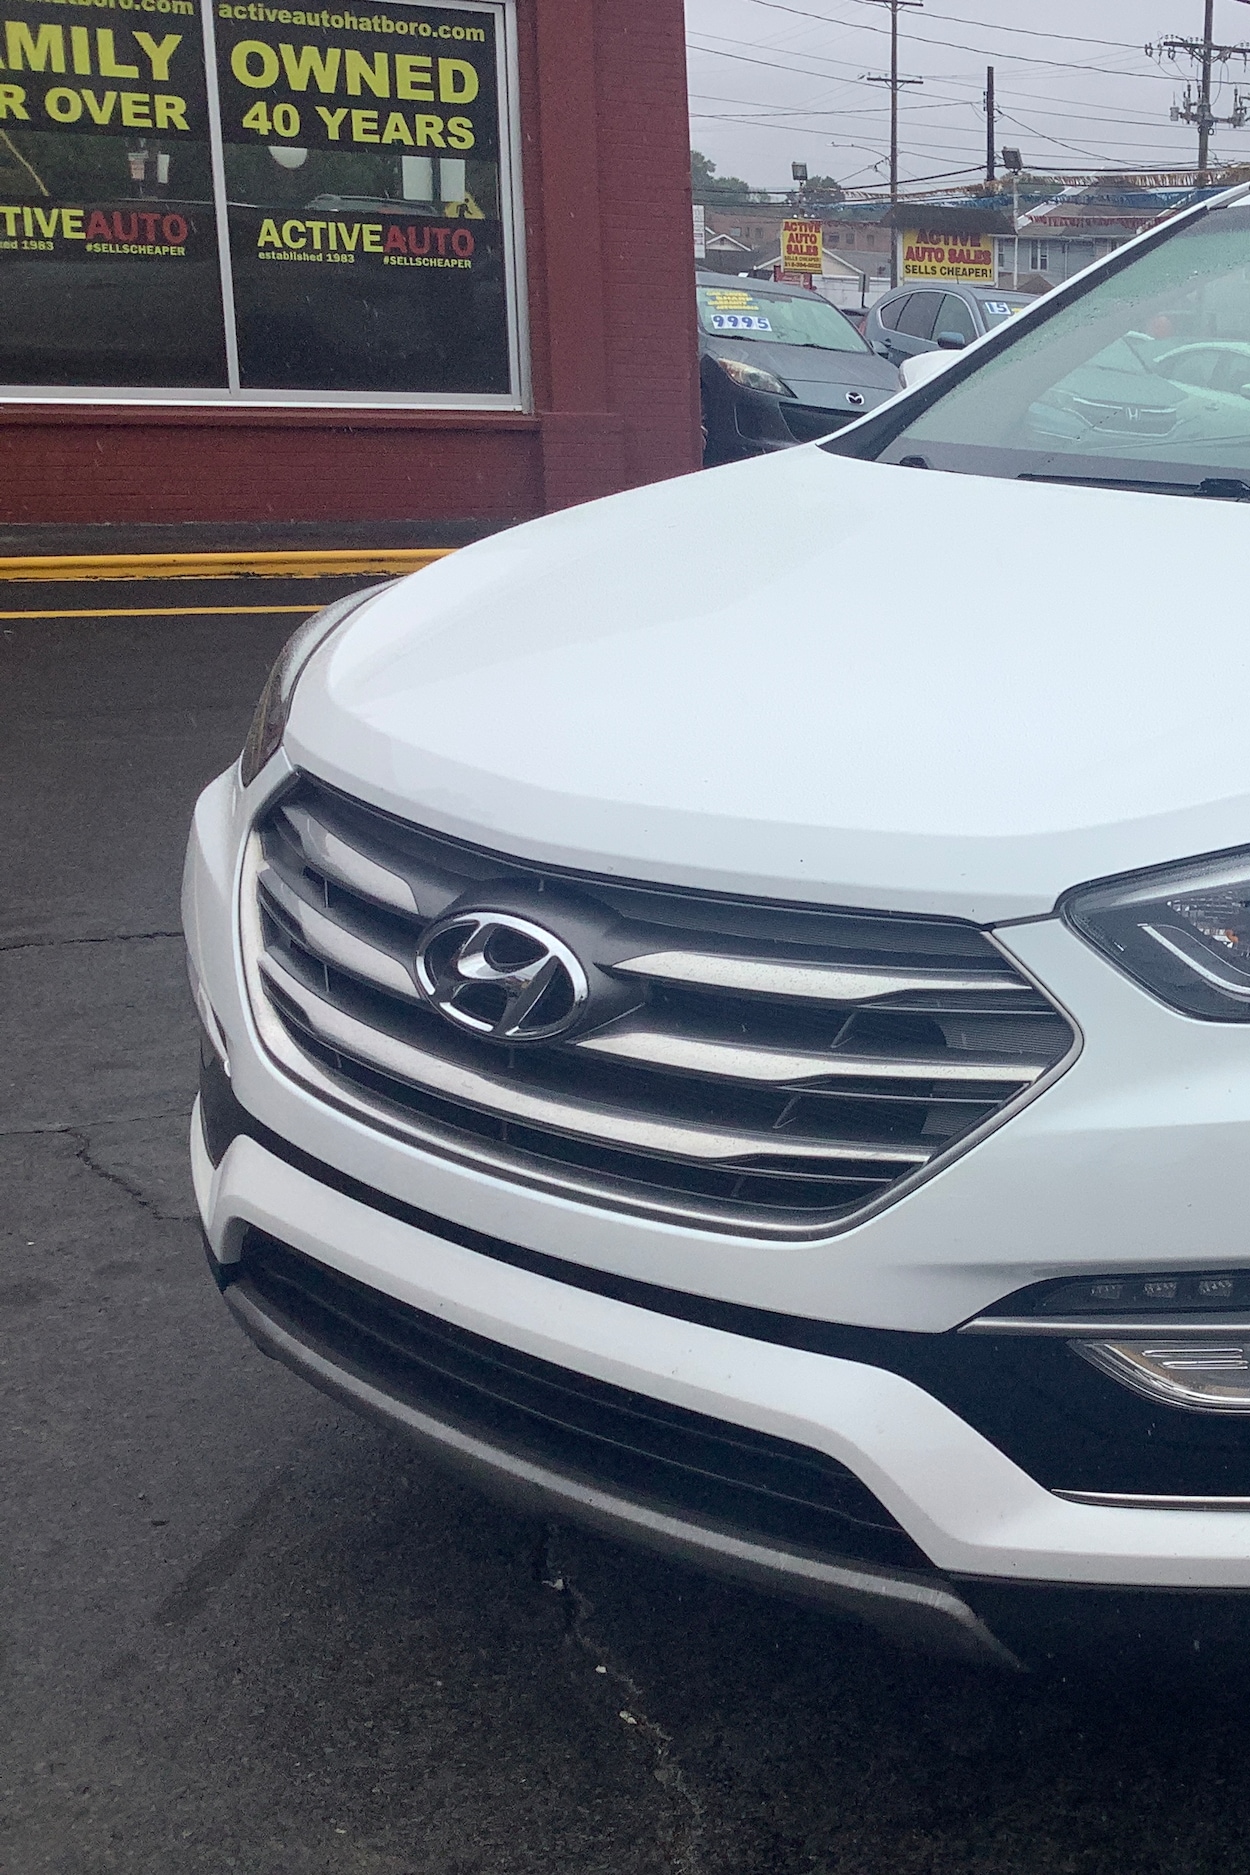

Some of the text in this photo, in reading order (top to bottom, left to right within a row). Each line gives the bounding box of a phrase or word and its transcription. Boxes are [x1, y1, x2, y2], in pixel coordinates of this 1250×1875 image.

[218, 3, 485, 42] activeautohatboro.com
[0, 21, 183, 81] MILY
[231, 40, 479, 104] OWNED
[44, 87, 190, 131] OVER
[242, 101, 476, 150] 40 YEARS
[784, 221, 821, 233] ACTIVE
[787, 232, 817, 244] AUTO
[916, 229, 981, 247] ACTIVE
[21, 240, 54, 251] 1983
[86, 243, 186, 256] #SELLSCHEAPER
[786, 244, 819, 256] SALES
[258, 250, 355, 263] established 1983
[383, 256, 472, 268] #SELLSCHEAPER
[904, 246, 992, 265] AUTO SALES
[905, 264, 992, 278] SELLS CHEAPER!
[988, 302, 1007, 313] 15
[713, 315, 769, 329] 9995
